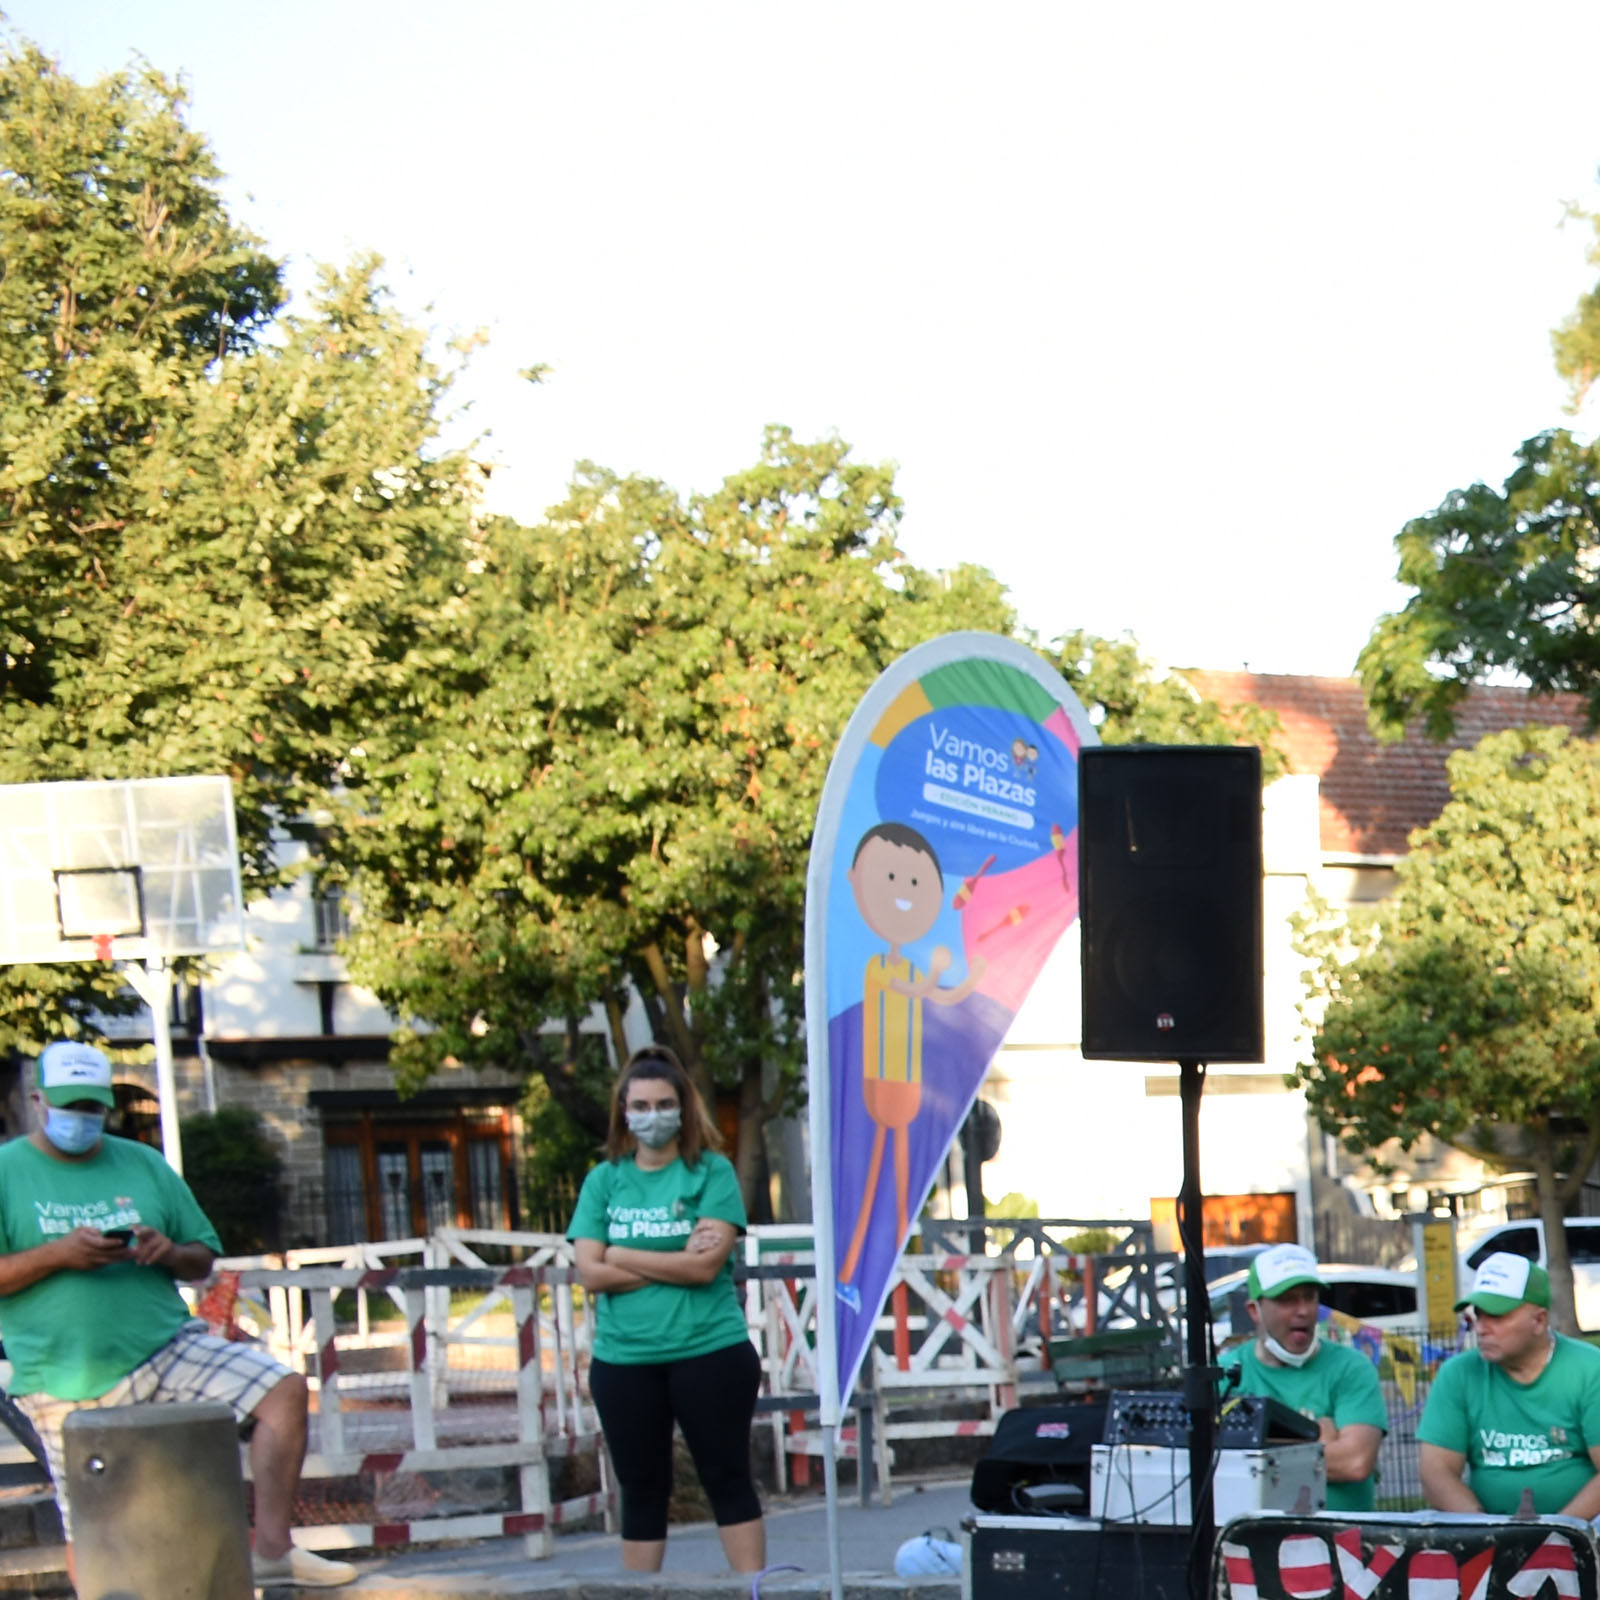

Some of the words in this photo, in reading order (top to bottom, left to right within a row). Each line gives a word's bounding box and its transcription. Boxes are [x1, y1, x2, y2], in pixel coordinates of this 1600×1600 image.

[930, 722, 1009, 773] Vamos
[925, 749, 959, 783] las
[963, 763, 1037, 807] Plazas
[34, 1199, 109, 1217] Vamos
[607, 1206, 668, 1222] Vamos
[39, 1215, 71, 1234] las
[609, 1222, 629, 1239] las
[632, 1220, 692, 1239] Plazas
[1480, 1429, 1549, 1449] Vamos
[1481, 1447, 1507, 1467] las
